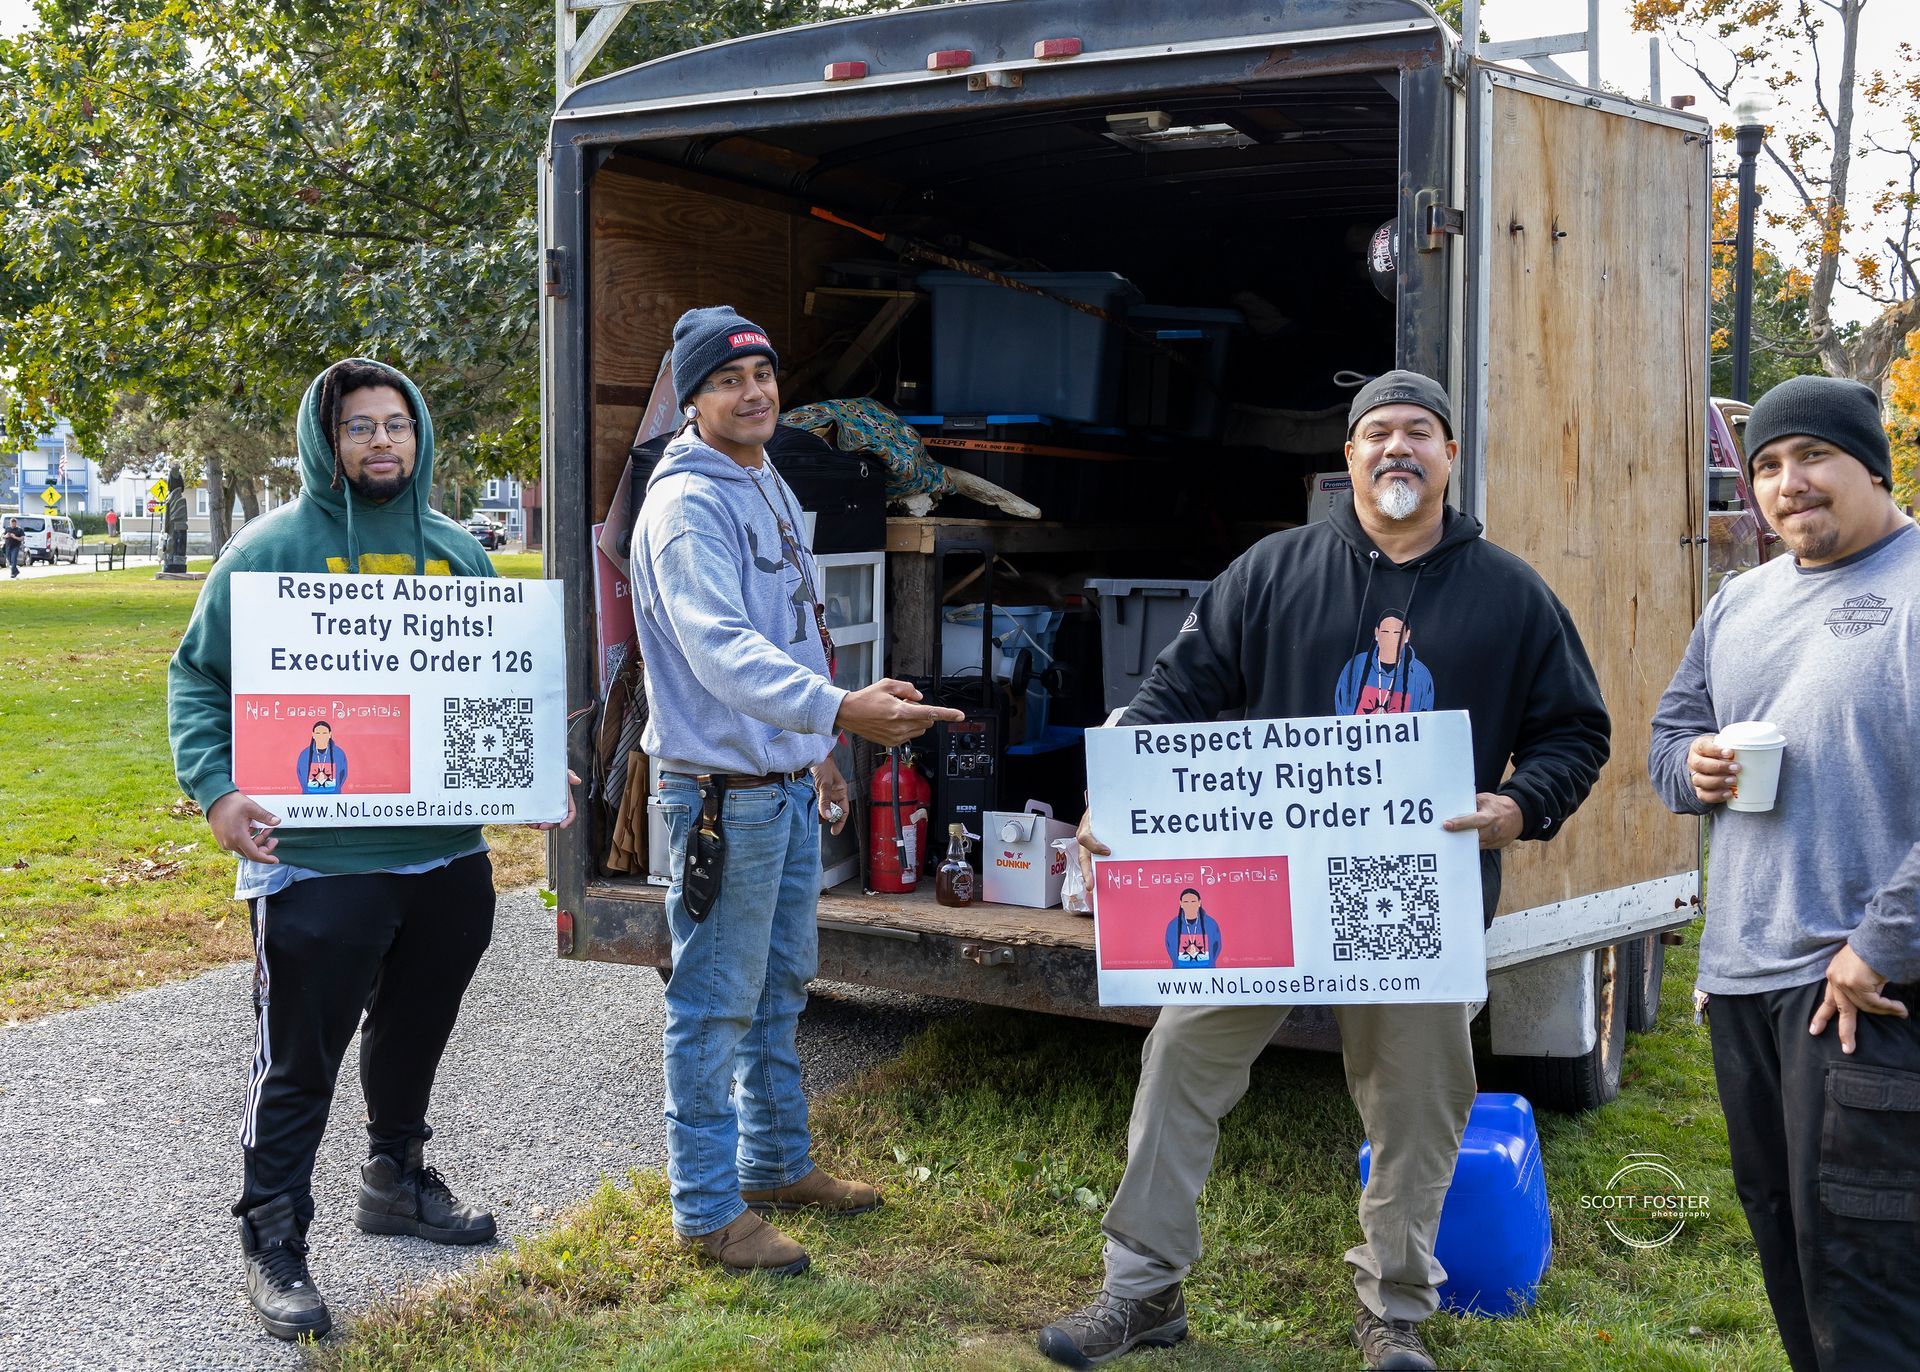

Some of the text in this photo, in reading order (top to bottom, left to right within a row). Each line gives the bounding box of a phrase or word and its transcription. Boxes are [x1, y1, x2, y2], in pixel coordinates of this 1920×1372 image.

[733, 334, 744, 345] All
[744, 333, 755, 344] My
[929, 438, 967, 447] KEEPER
[278, 576, 524, 607] Respect Aboriginal
[312, 612, 493, 643] Treaty Rights!
[271, 648, 533, 673] Executive Order 126
[246, 700, 270, 720] No
[332, 701, 401, 719] Braids
[1134, 716, 1420, 758] Respect Aboriginal
[1172, 759, 1383, 797] Treaty Rights!
[287, 800, 515, 819] www.NoLooseBraids.com
[1130, 798, 1434, 835] Executive Order 126
[996, 858, 1031, 869] DUNKIN'
[1107, 868, 1132, 889] No
[1200, 865, 1278, 886] Braids
[1158, 975, 1421, 995] www.NoLooseBraids.com
